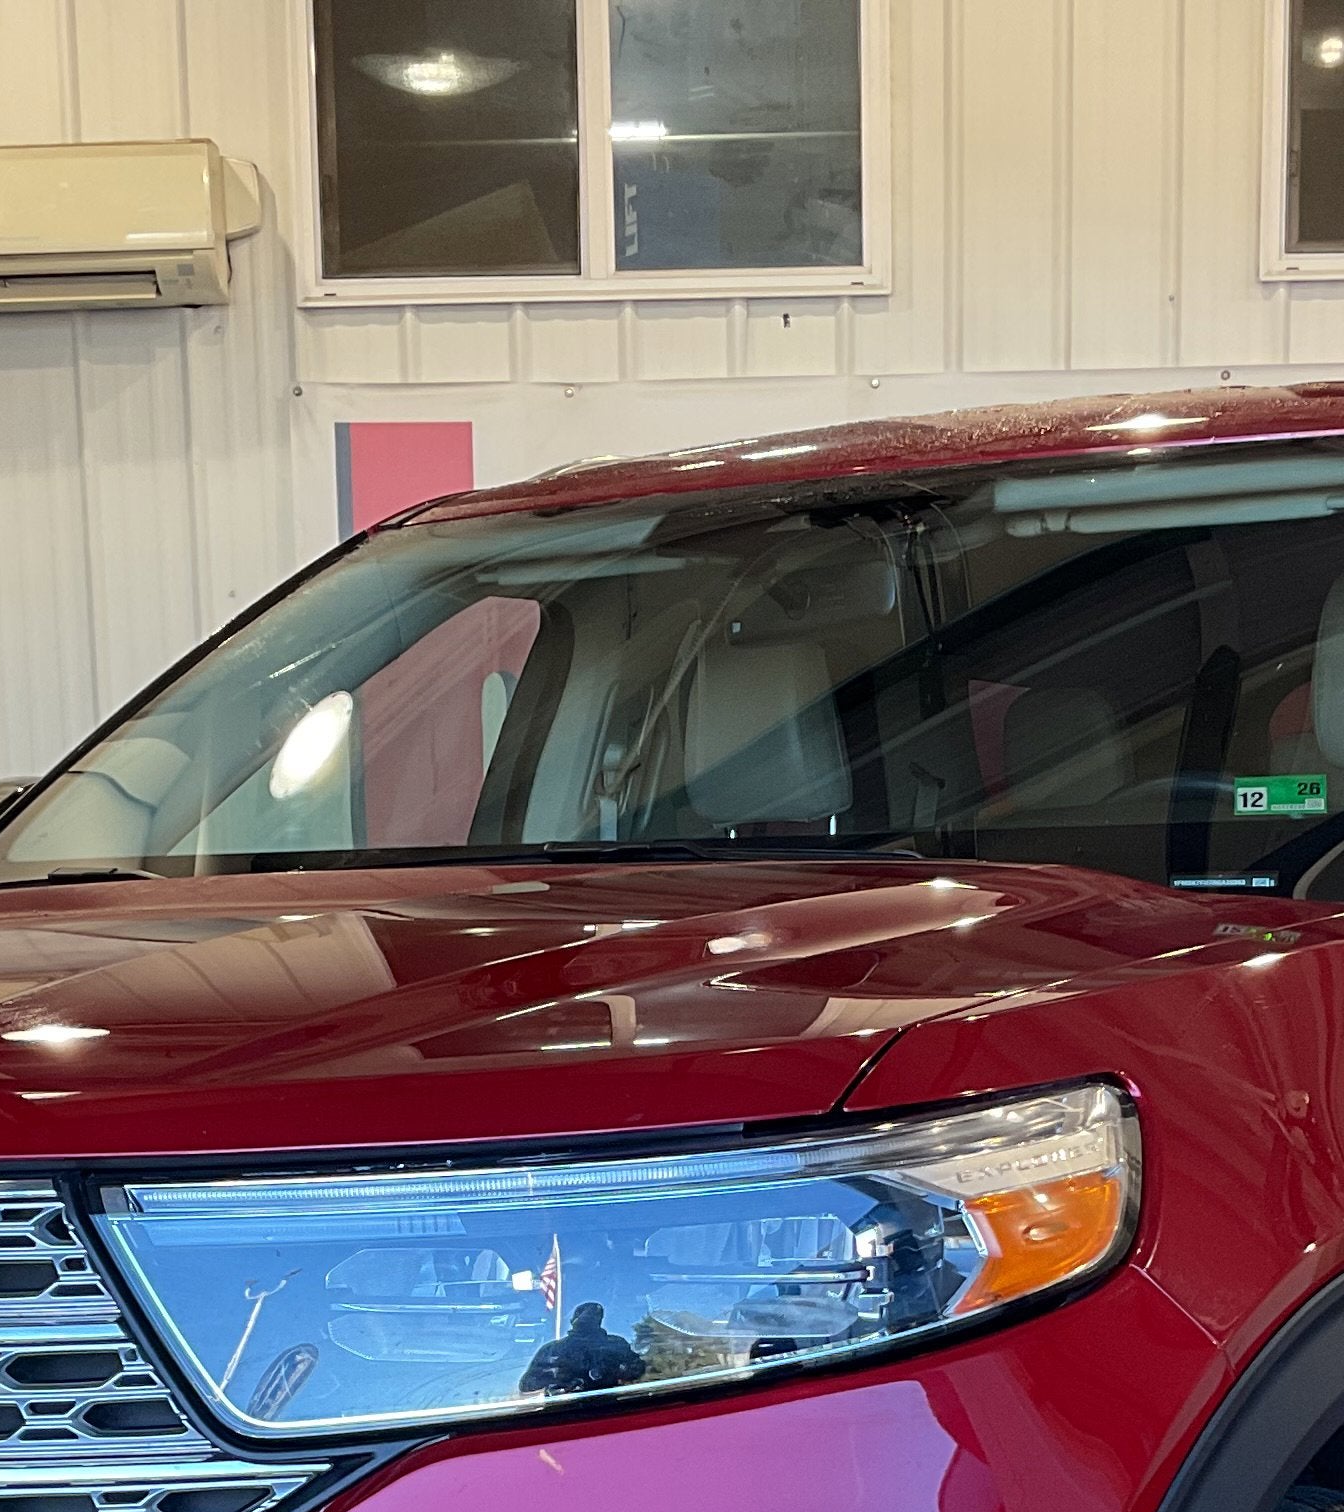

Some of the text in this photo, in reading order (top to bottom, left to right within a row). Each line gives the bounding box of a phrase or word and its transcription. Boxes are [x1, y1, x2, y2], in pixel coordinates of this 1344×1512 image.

[624, 183, 638, 256] LIFT
[1297, 782, 1321, 796] 26
[1238, 791, 1264, 808] 12
